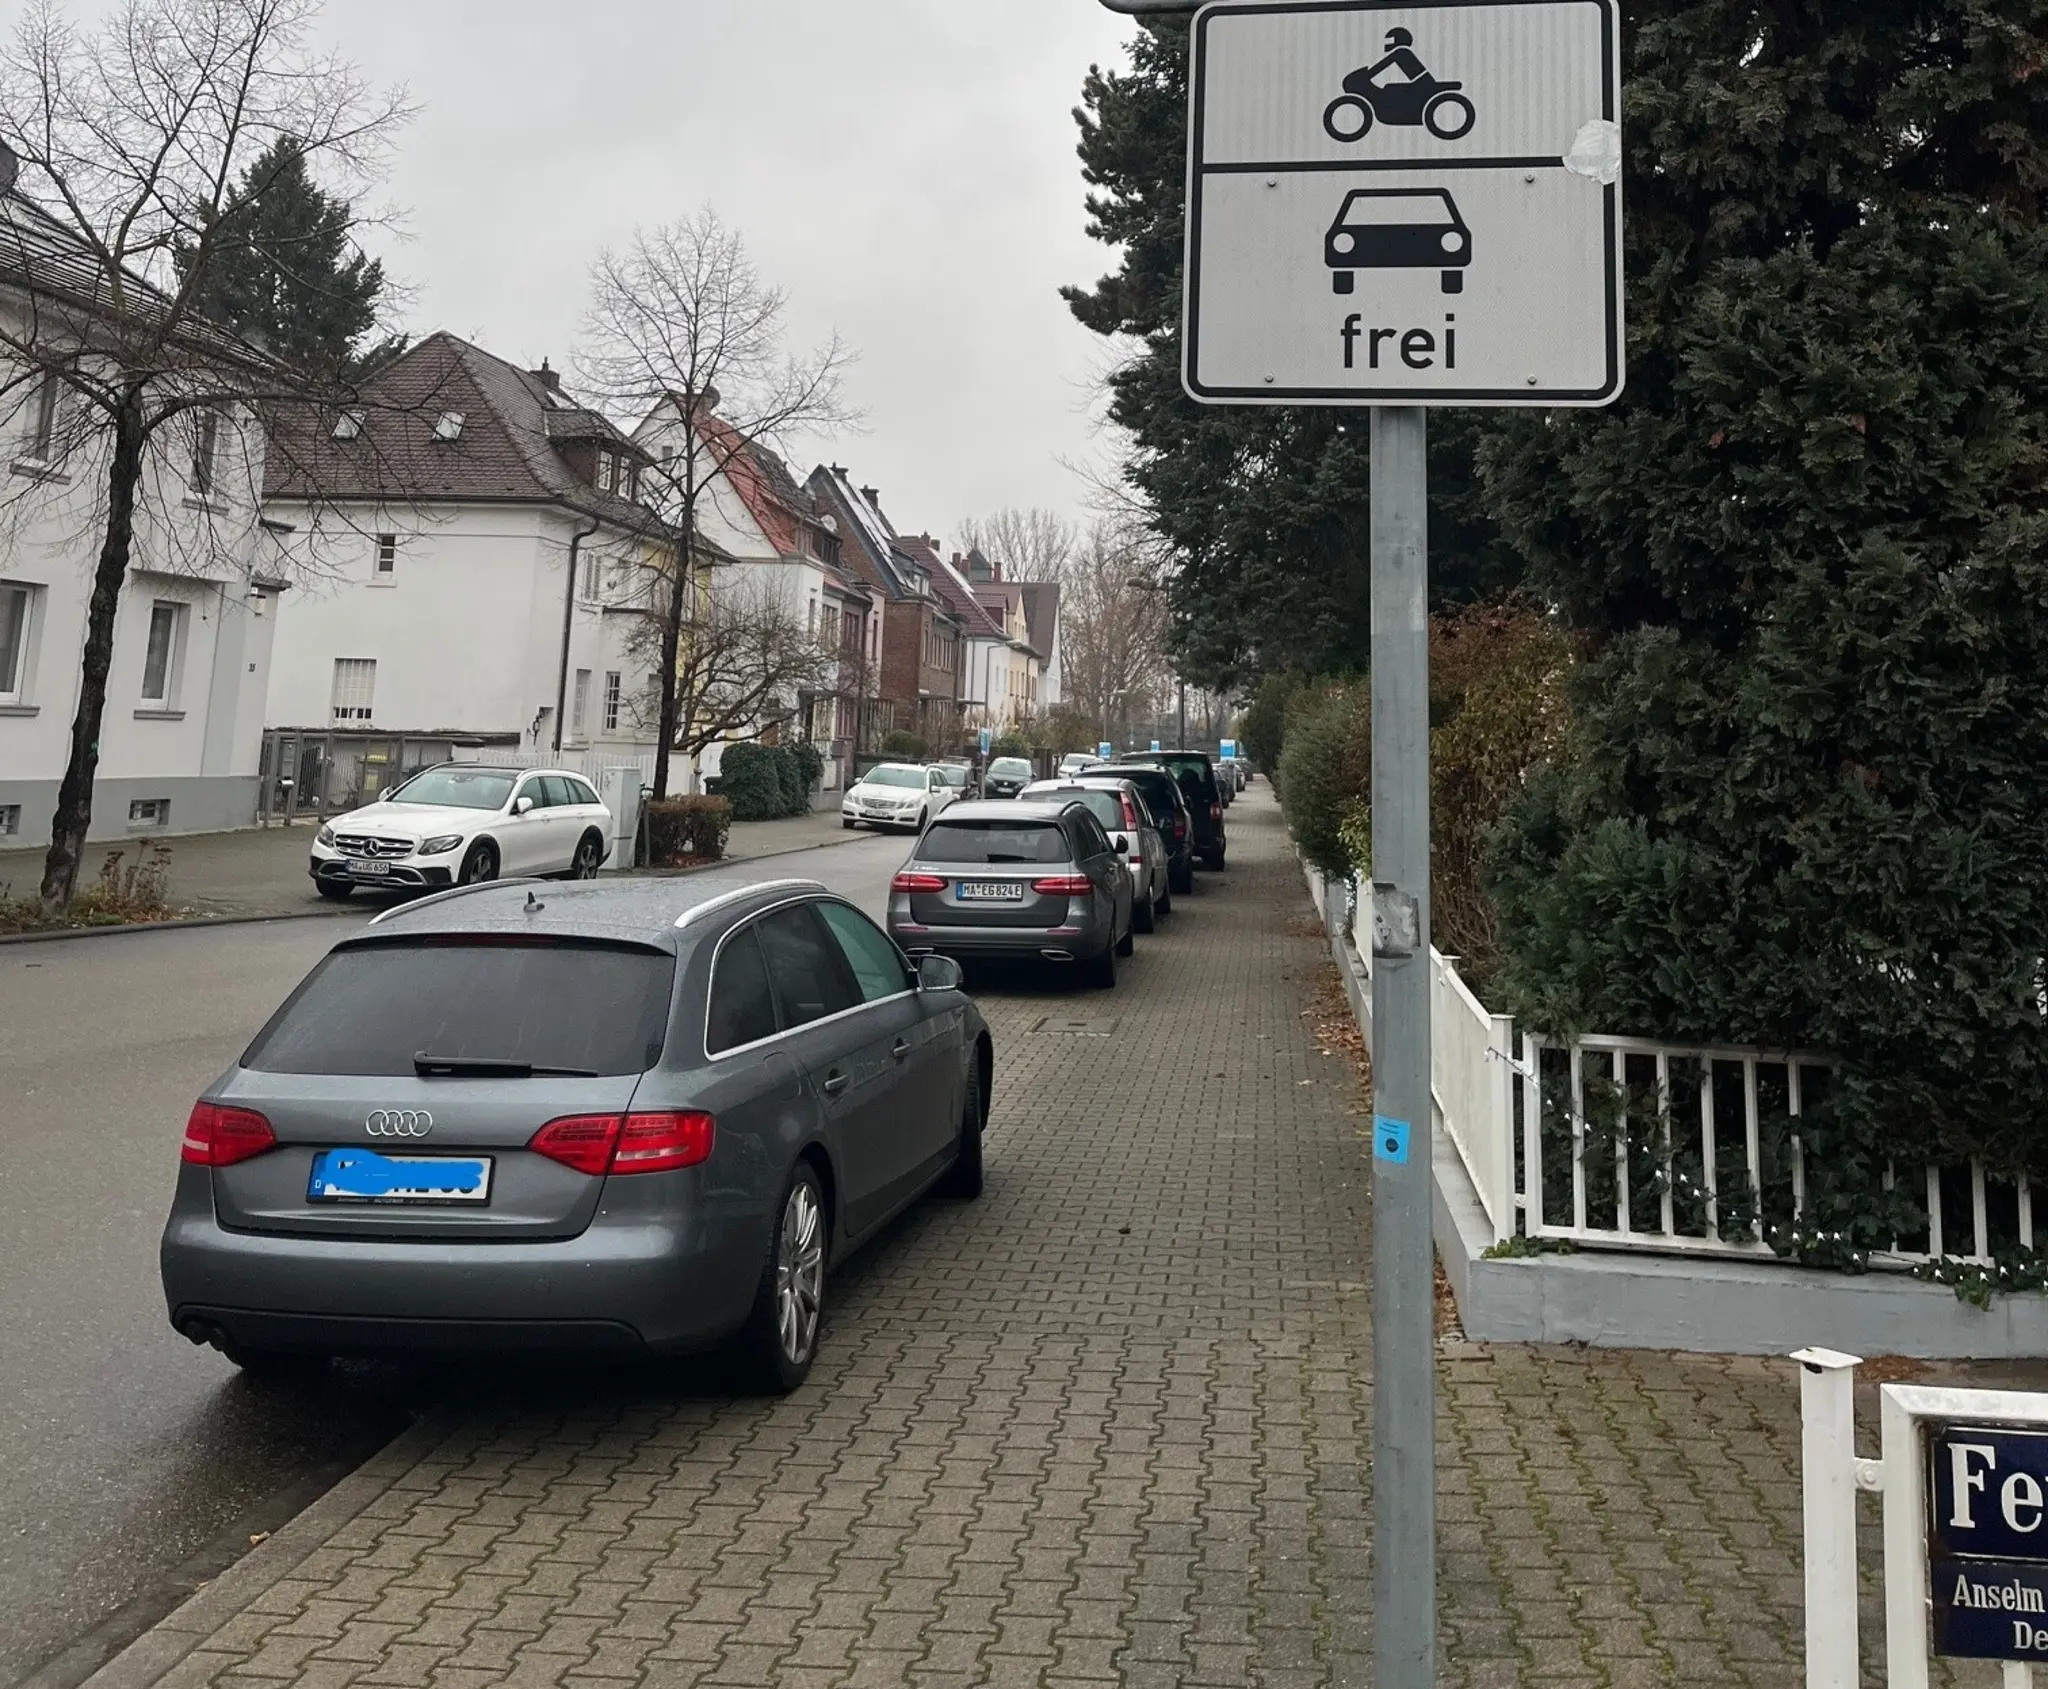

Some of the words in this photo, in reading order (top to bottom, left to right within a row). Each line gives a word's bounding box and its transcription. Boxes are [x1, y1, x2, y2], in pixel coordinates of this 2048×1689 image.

[1340, 313, 1455, 369] frei
[963, 884, 976, 896] MA
[1947, 1443, 2048, 1533] Fe
[1952, 1574, 2046, 1613] Anselm
